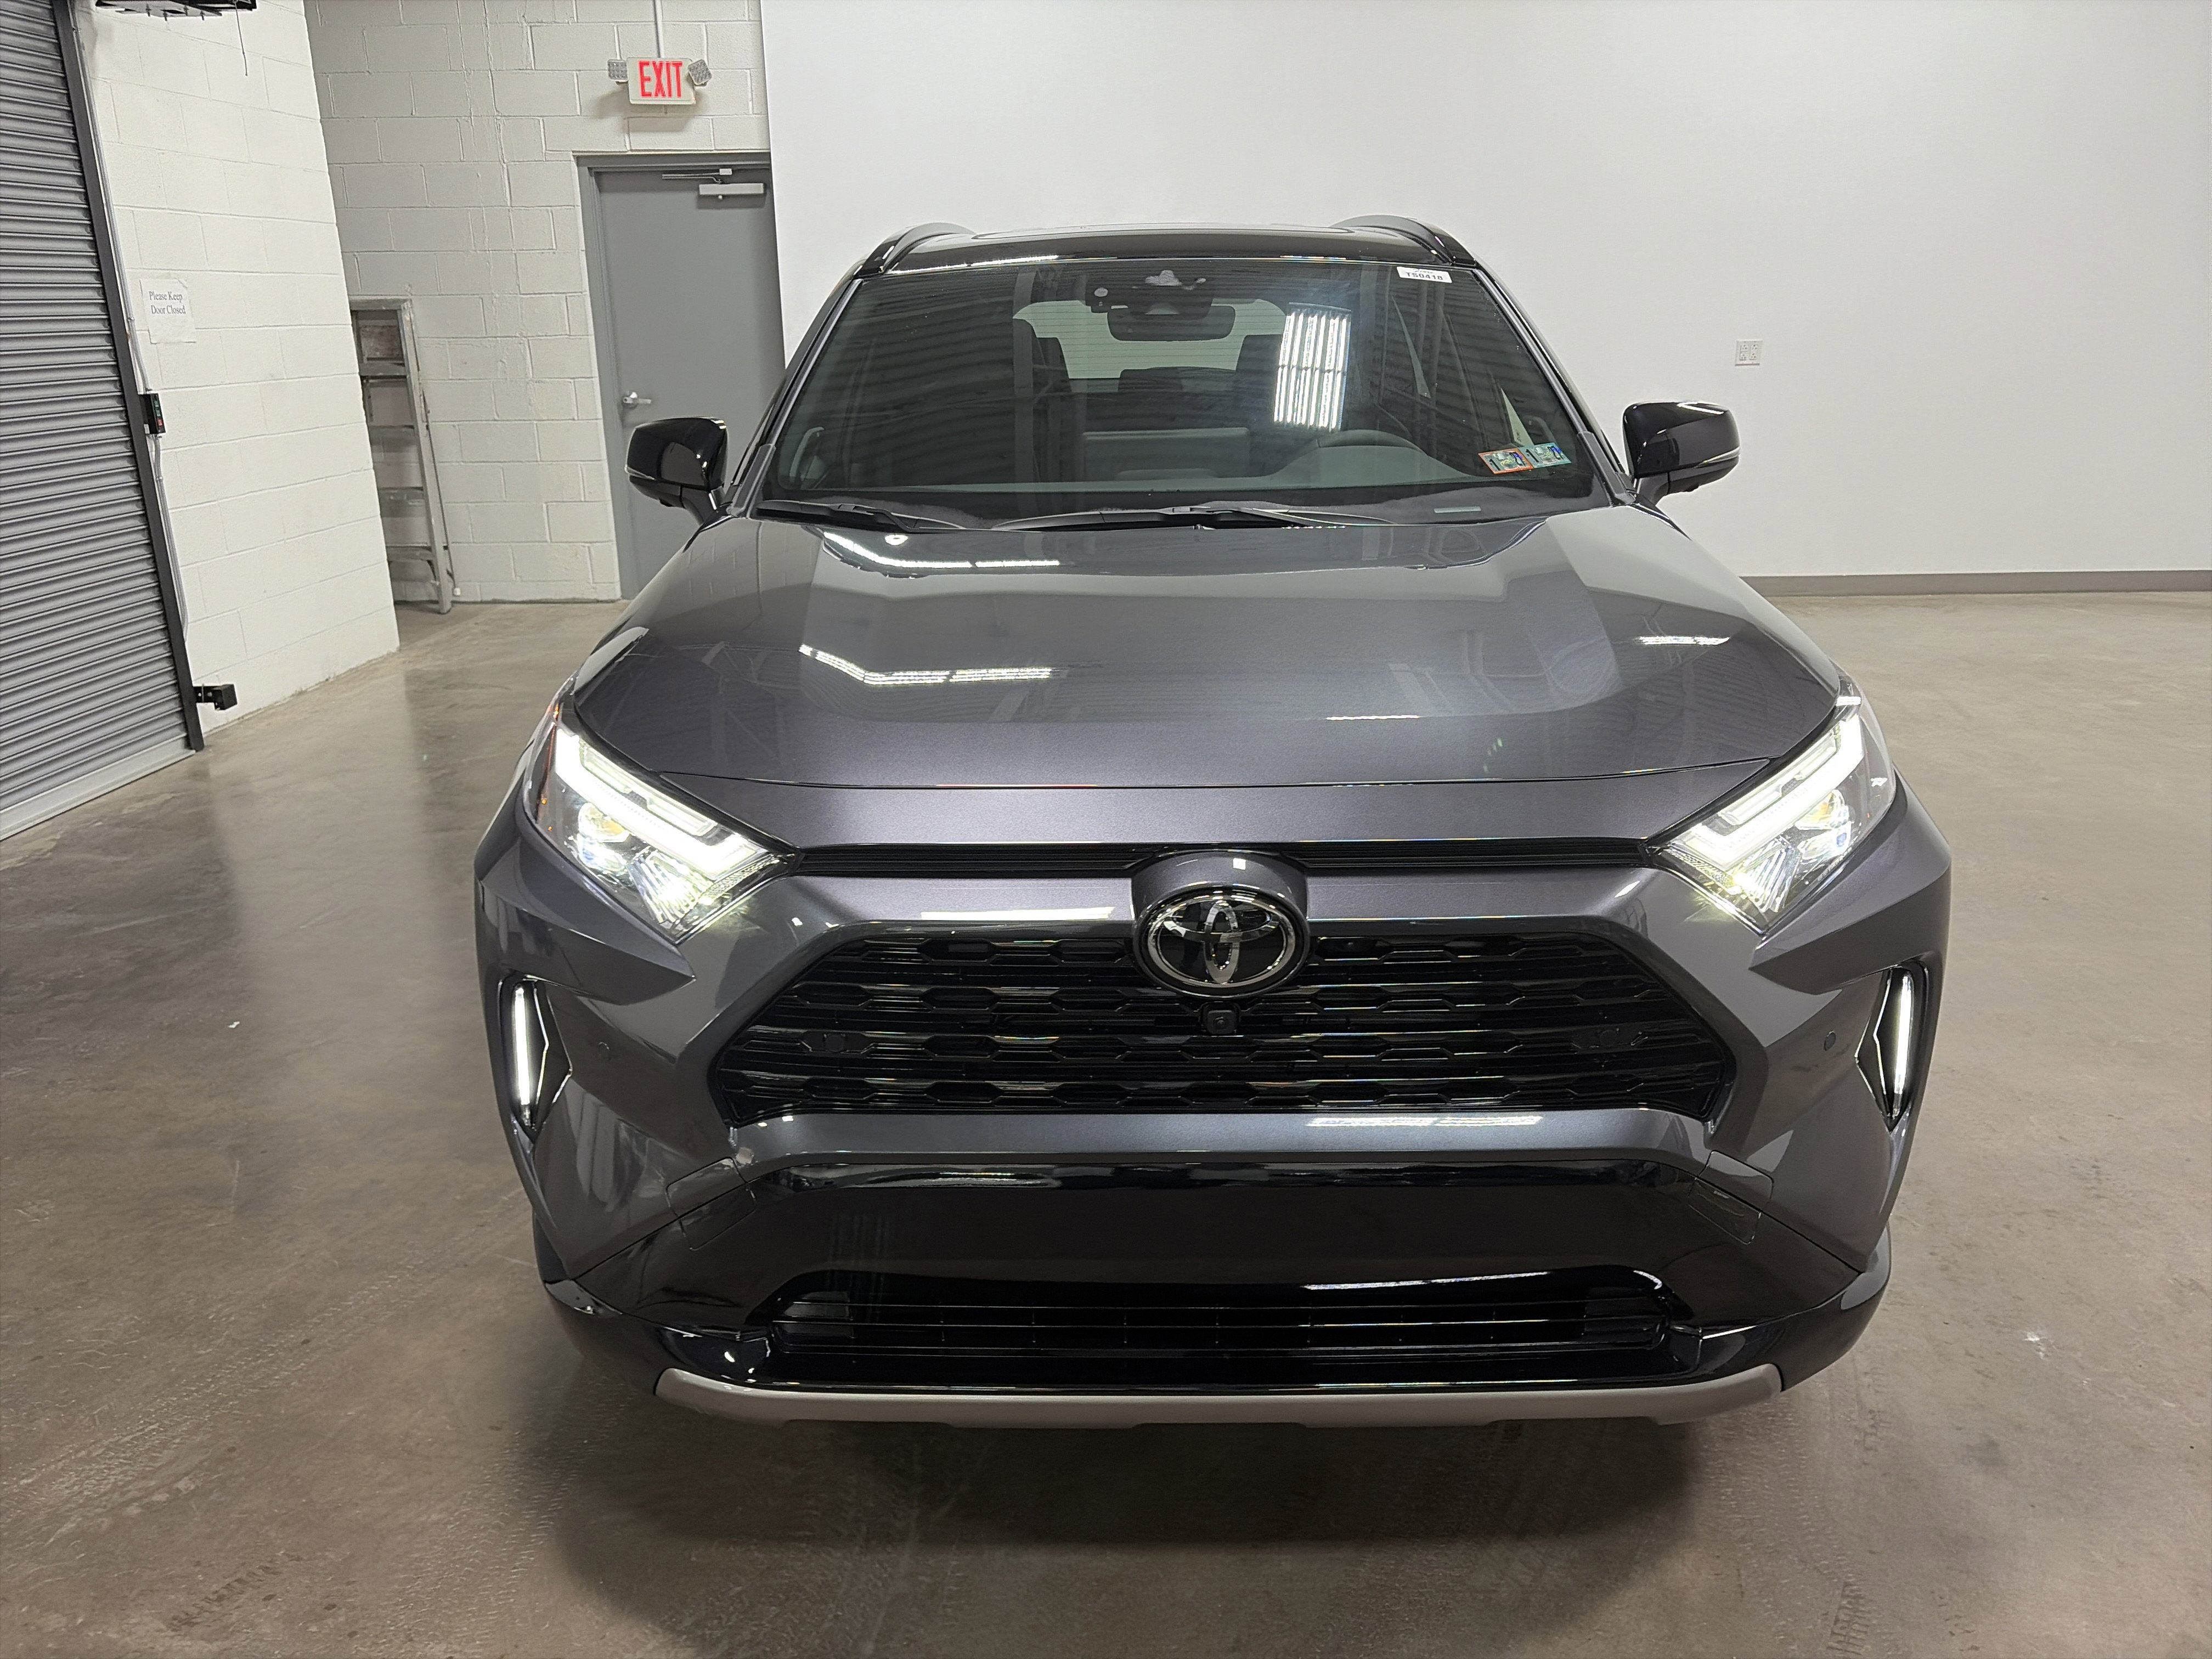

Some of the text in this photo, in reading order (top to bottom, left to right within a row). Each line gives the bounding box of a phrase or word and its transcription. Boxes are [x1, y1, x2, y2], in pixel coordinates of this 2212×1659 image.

[638, 60, 683, 98] EXIT
[149, 291, 183, 303] Please Keep
[151, 304, 186, 314] Door Closed
